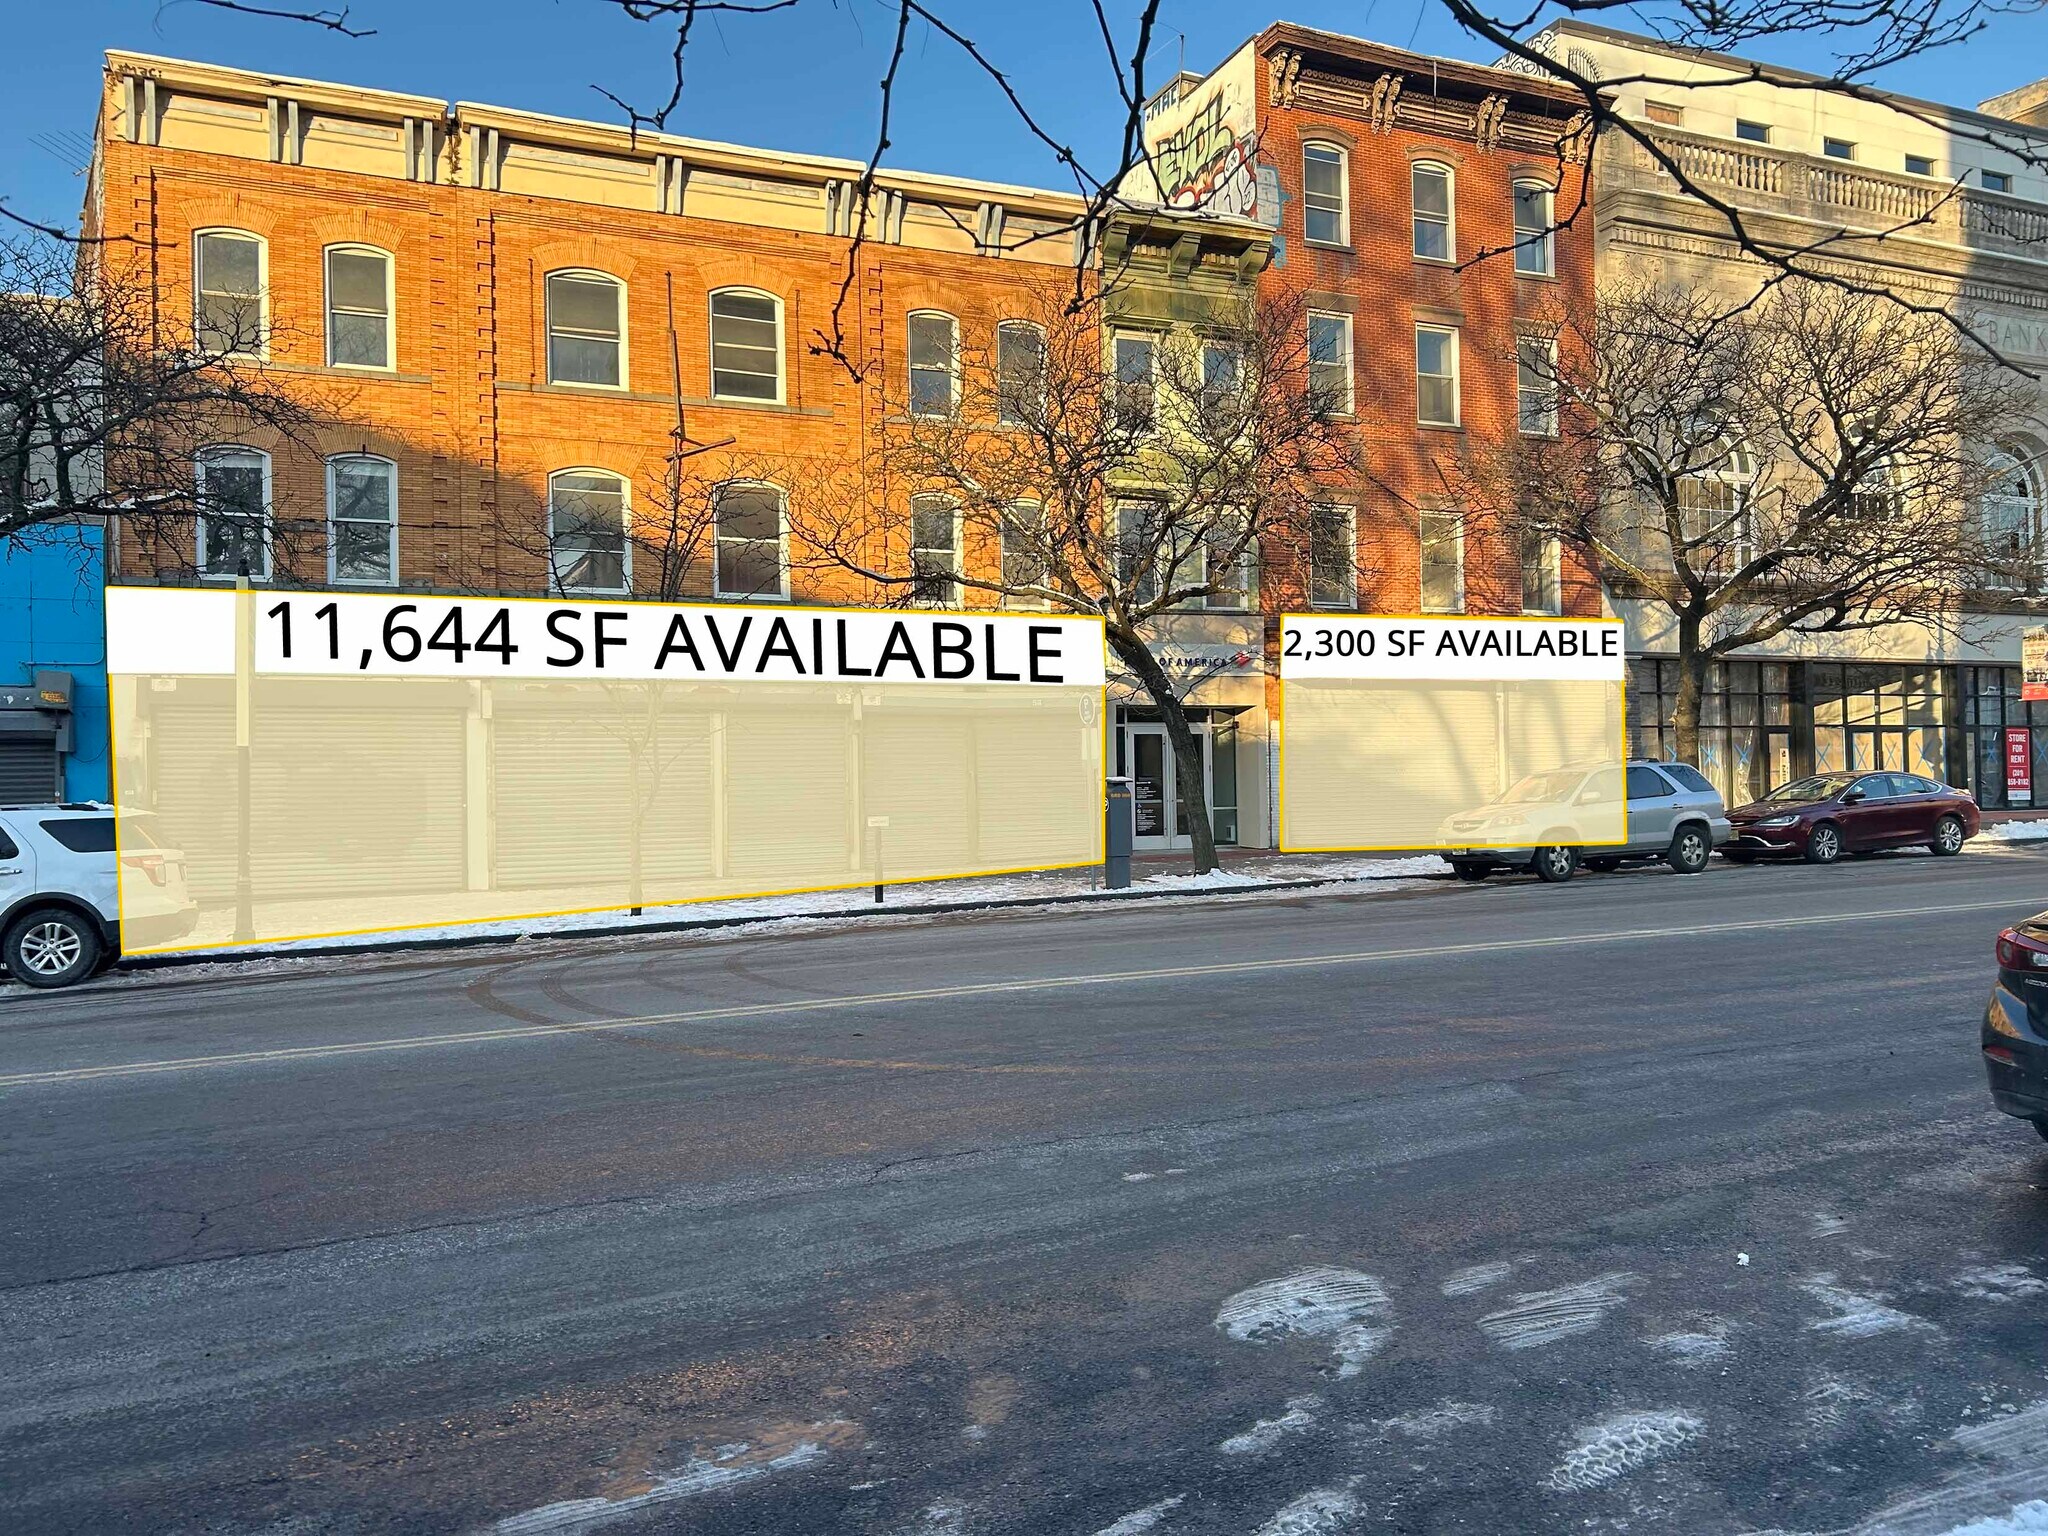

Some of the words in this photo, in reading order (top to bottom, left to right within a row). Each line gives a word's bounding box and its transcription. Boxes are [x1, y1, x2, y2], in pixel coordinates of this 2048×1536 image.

[1989, 321, 2048, 352] BANK
[1159, 657, 1173, 666] OF
[1176, 657, 1227, 667] AMERICA
[2008, 734, 2026, 742] STORE
[2012, 745, 2023, 753] FOR
[2010, 755, 2025, 763] RENT
